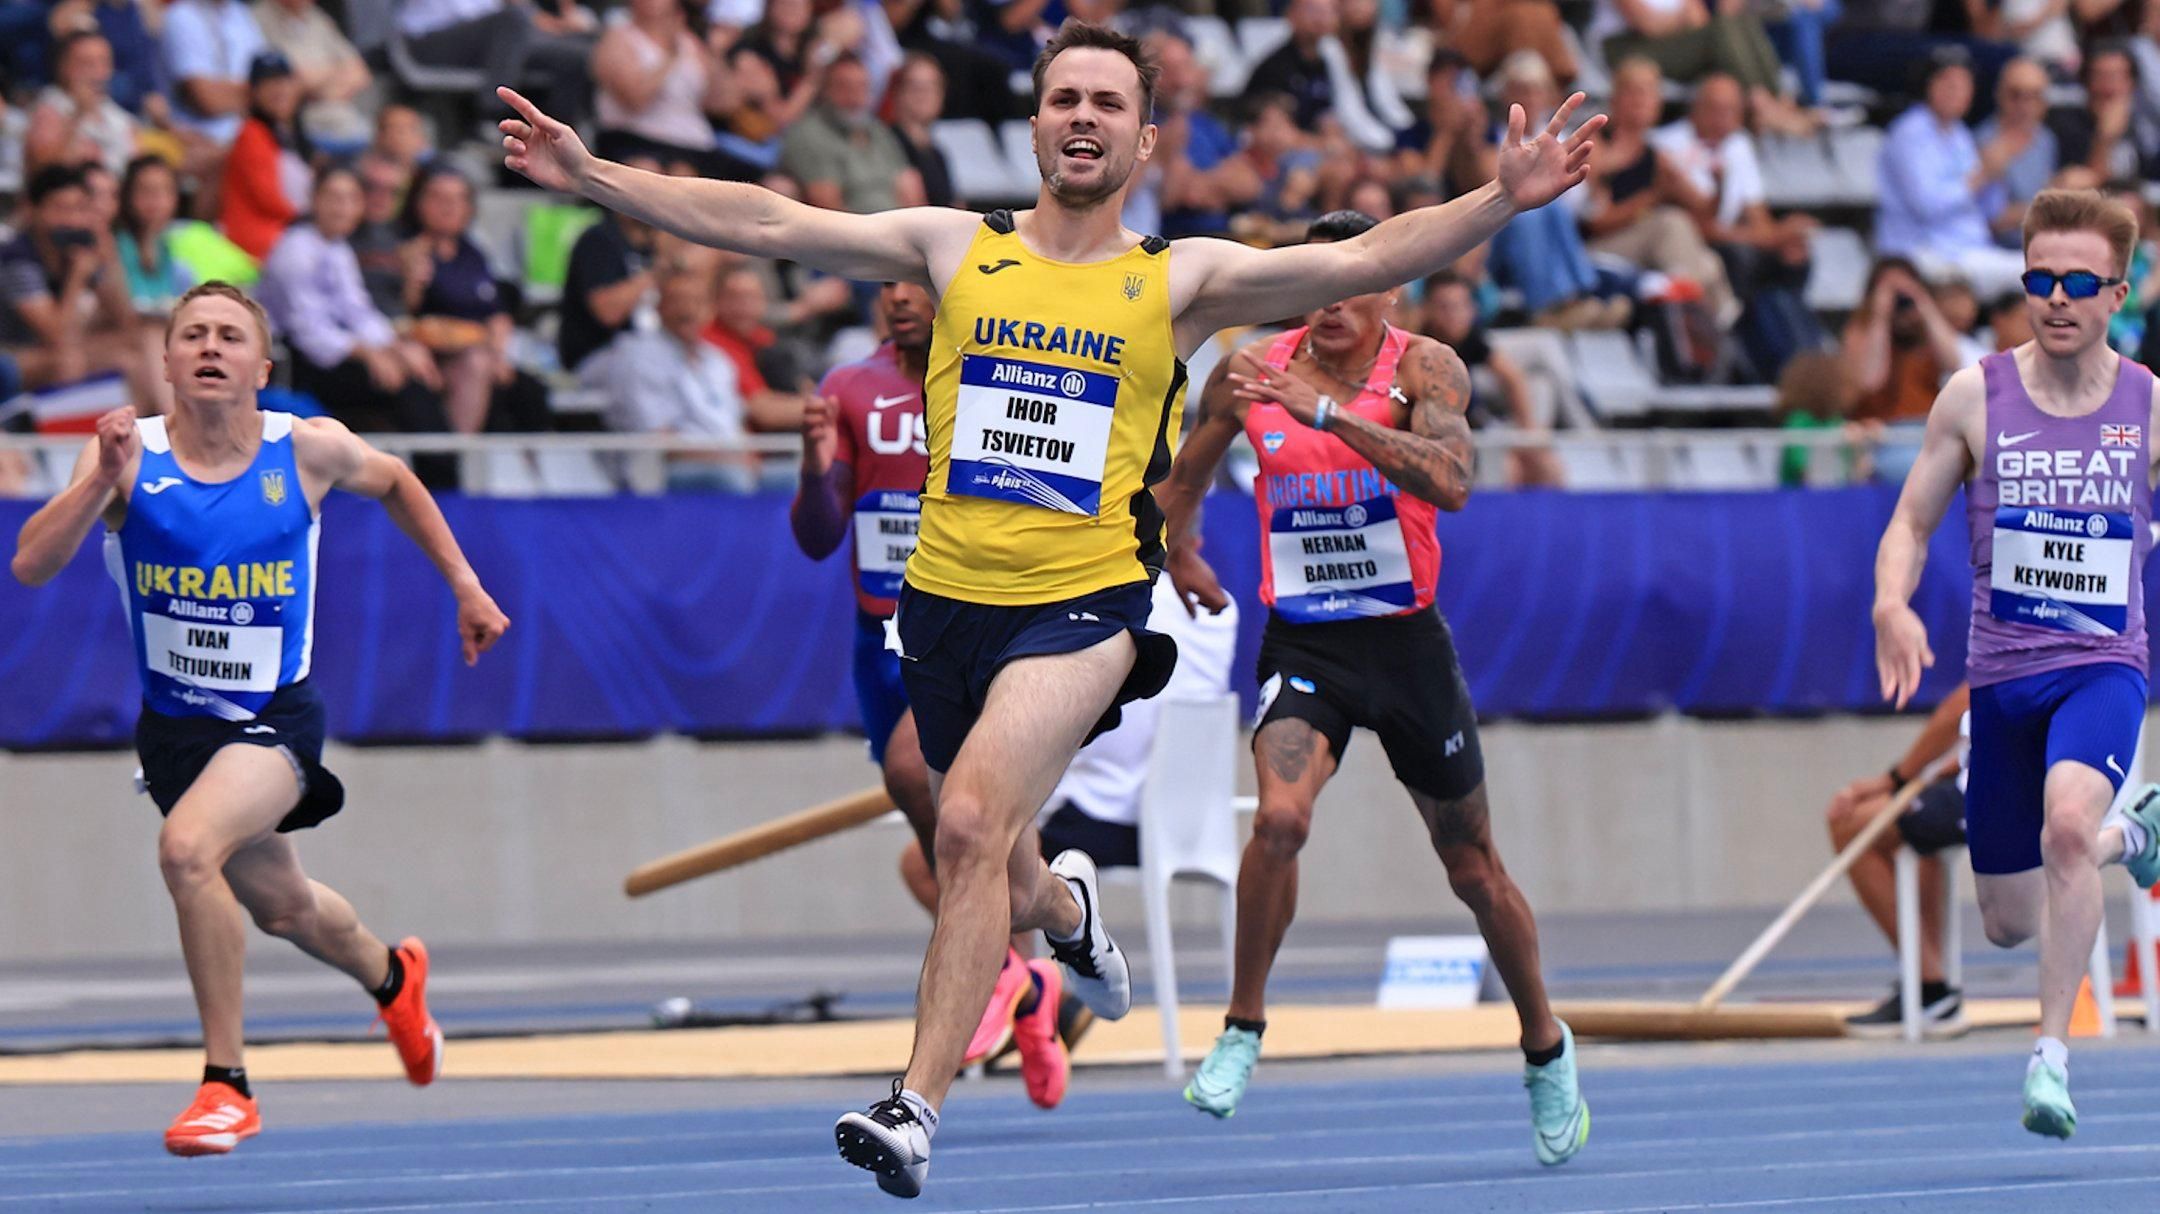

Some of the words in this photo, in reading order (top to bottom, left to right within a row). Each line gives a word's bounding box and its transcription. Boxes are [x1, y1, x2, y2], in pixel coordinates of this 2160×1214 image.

[975, 317, 1126, 366] UKRAINE
[991, 363, 1056, 390] Allianz
[1006, 396, 1058, 425] IHOR
[981, 428, 1075, 464] TSVIETOV
[1996, 450, 2136, 478] GREAT
[1998, 479, 2133, 506] BRITAIN
[1291, 509, 1344, 528] Allianz
[2023, 510, 2085, 533] Allianz
[1302, 533, 1367, 555] HERNAN
[2043, 540, 2085, 563] KYLE
[136, 560, 296, 600] UKRAINE
[1303, 559, 1378, 583] BARRETO
[2013, 565, 2108, 594] KEYWORTH
[168, 598, 228, 620] Allianz
[187, 628, 230, 650] IVAN
[167, 650, 253, 681] TETIUKHIN
